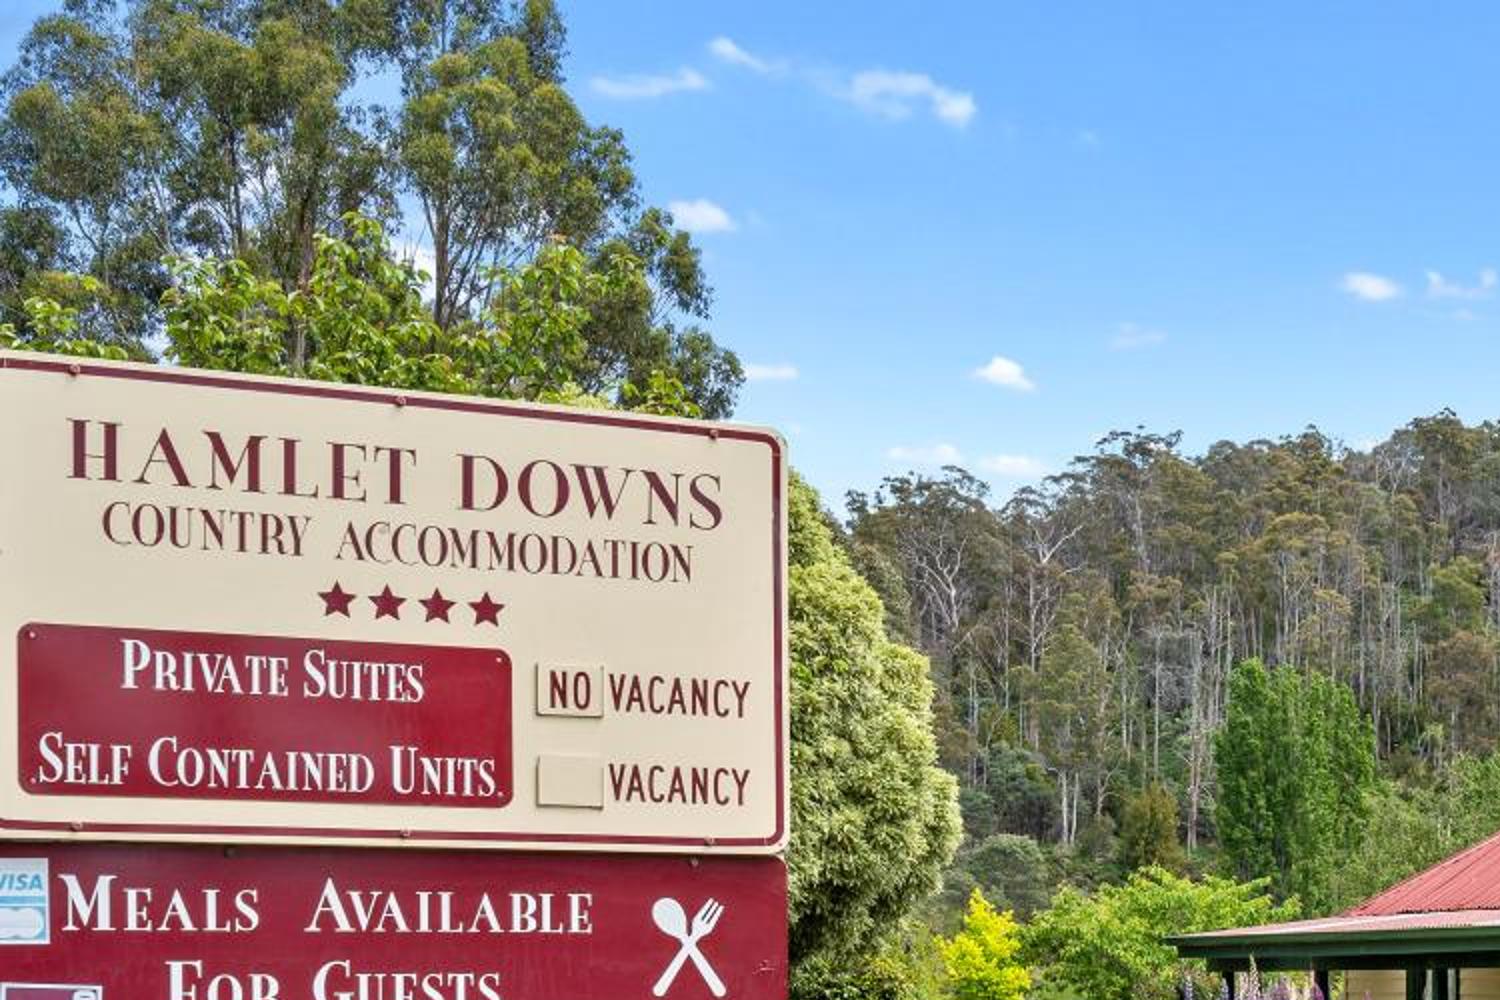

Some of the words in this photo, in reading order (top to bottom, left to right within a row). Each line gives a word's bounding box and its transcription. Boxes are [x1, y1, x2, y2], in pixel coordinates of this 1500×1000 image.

[67, 418, 416, 504] HAMLET
[456, 453, 723, 530] DOWNS
[102, 502, 312, 556] COUNTRY
[336, 520, 694, 582] ACCOMMODATION
[120, 640, 288, 696] PRIVATE
[303, 650, 425, 702] SUITES
[549, 669, 590, 711] NO
[610, 673, 750, 718] VACANCY
[38, 732, 132, 785] SELF
[148, 736, 374, 793] CONTAINED
[610, 763, 750, 805] VACANCY
[58, 874, 260, 932] MEALS
[305, 876, 593, 935] AVAILABLE
